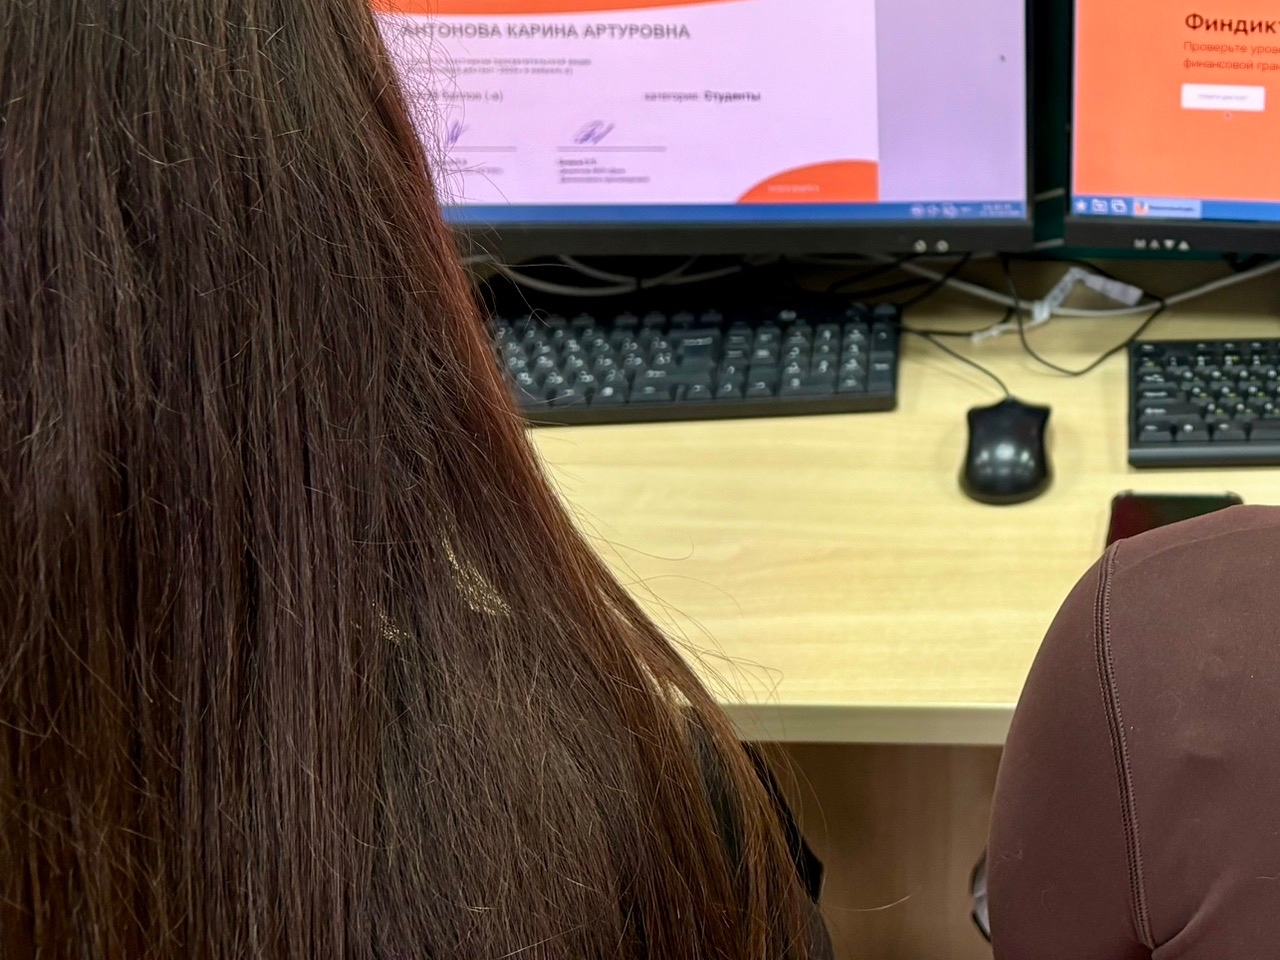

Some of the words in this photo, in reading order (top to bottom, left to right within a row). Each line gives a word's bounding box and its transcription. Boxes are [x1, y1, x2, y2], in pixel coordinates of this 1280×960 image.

[402, 22, 500, 39] АНТОНОВА
[507, 23, 577, 38] КАРИНА
[583, 23, 690, 39] АРТУРОВНА
[1183, 41, 1248, 54] Проверьте
[1183, 58, 1254, 70] финансовой
[704, 90, 761, 104] Студенты
